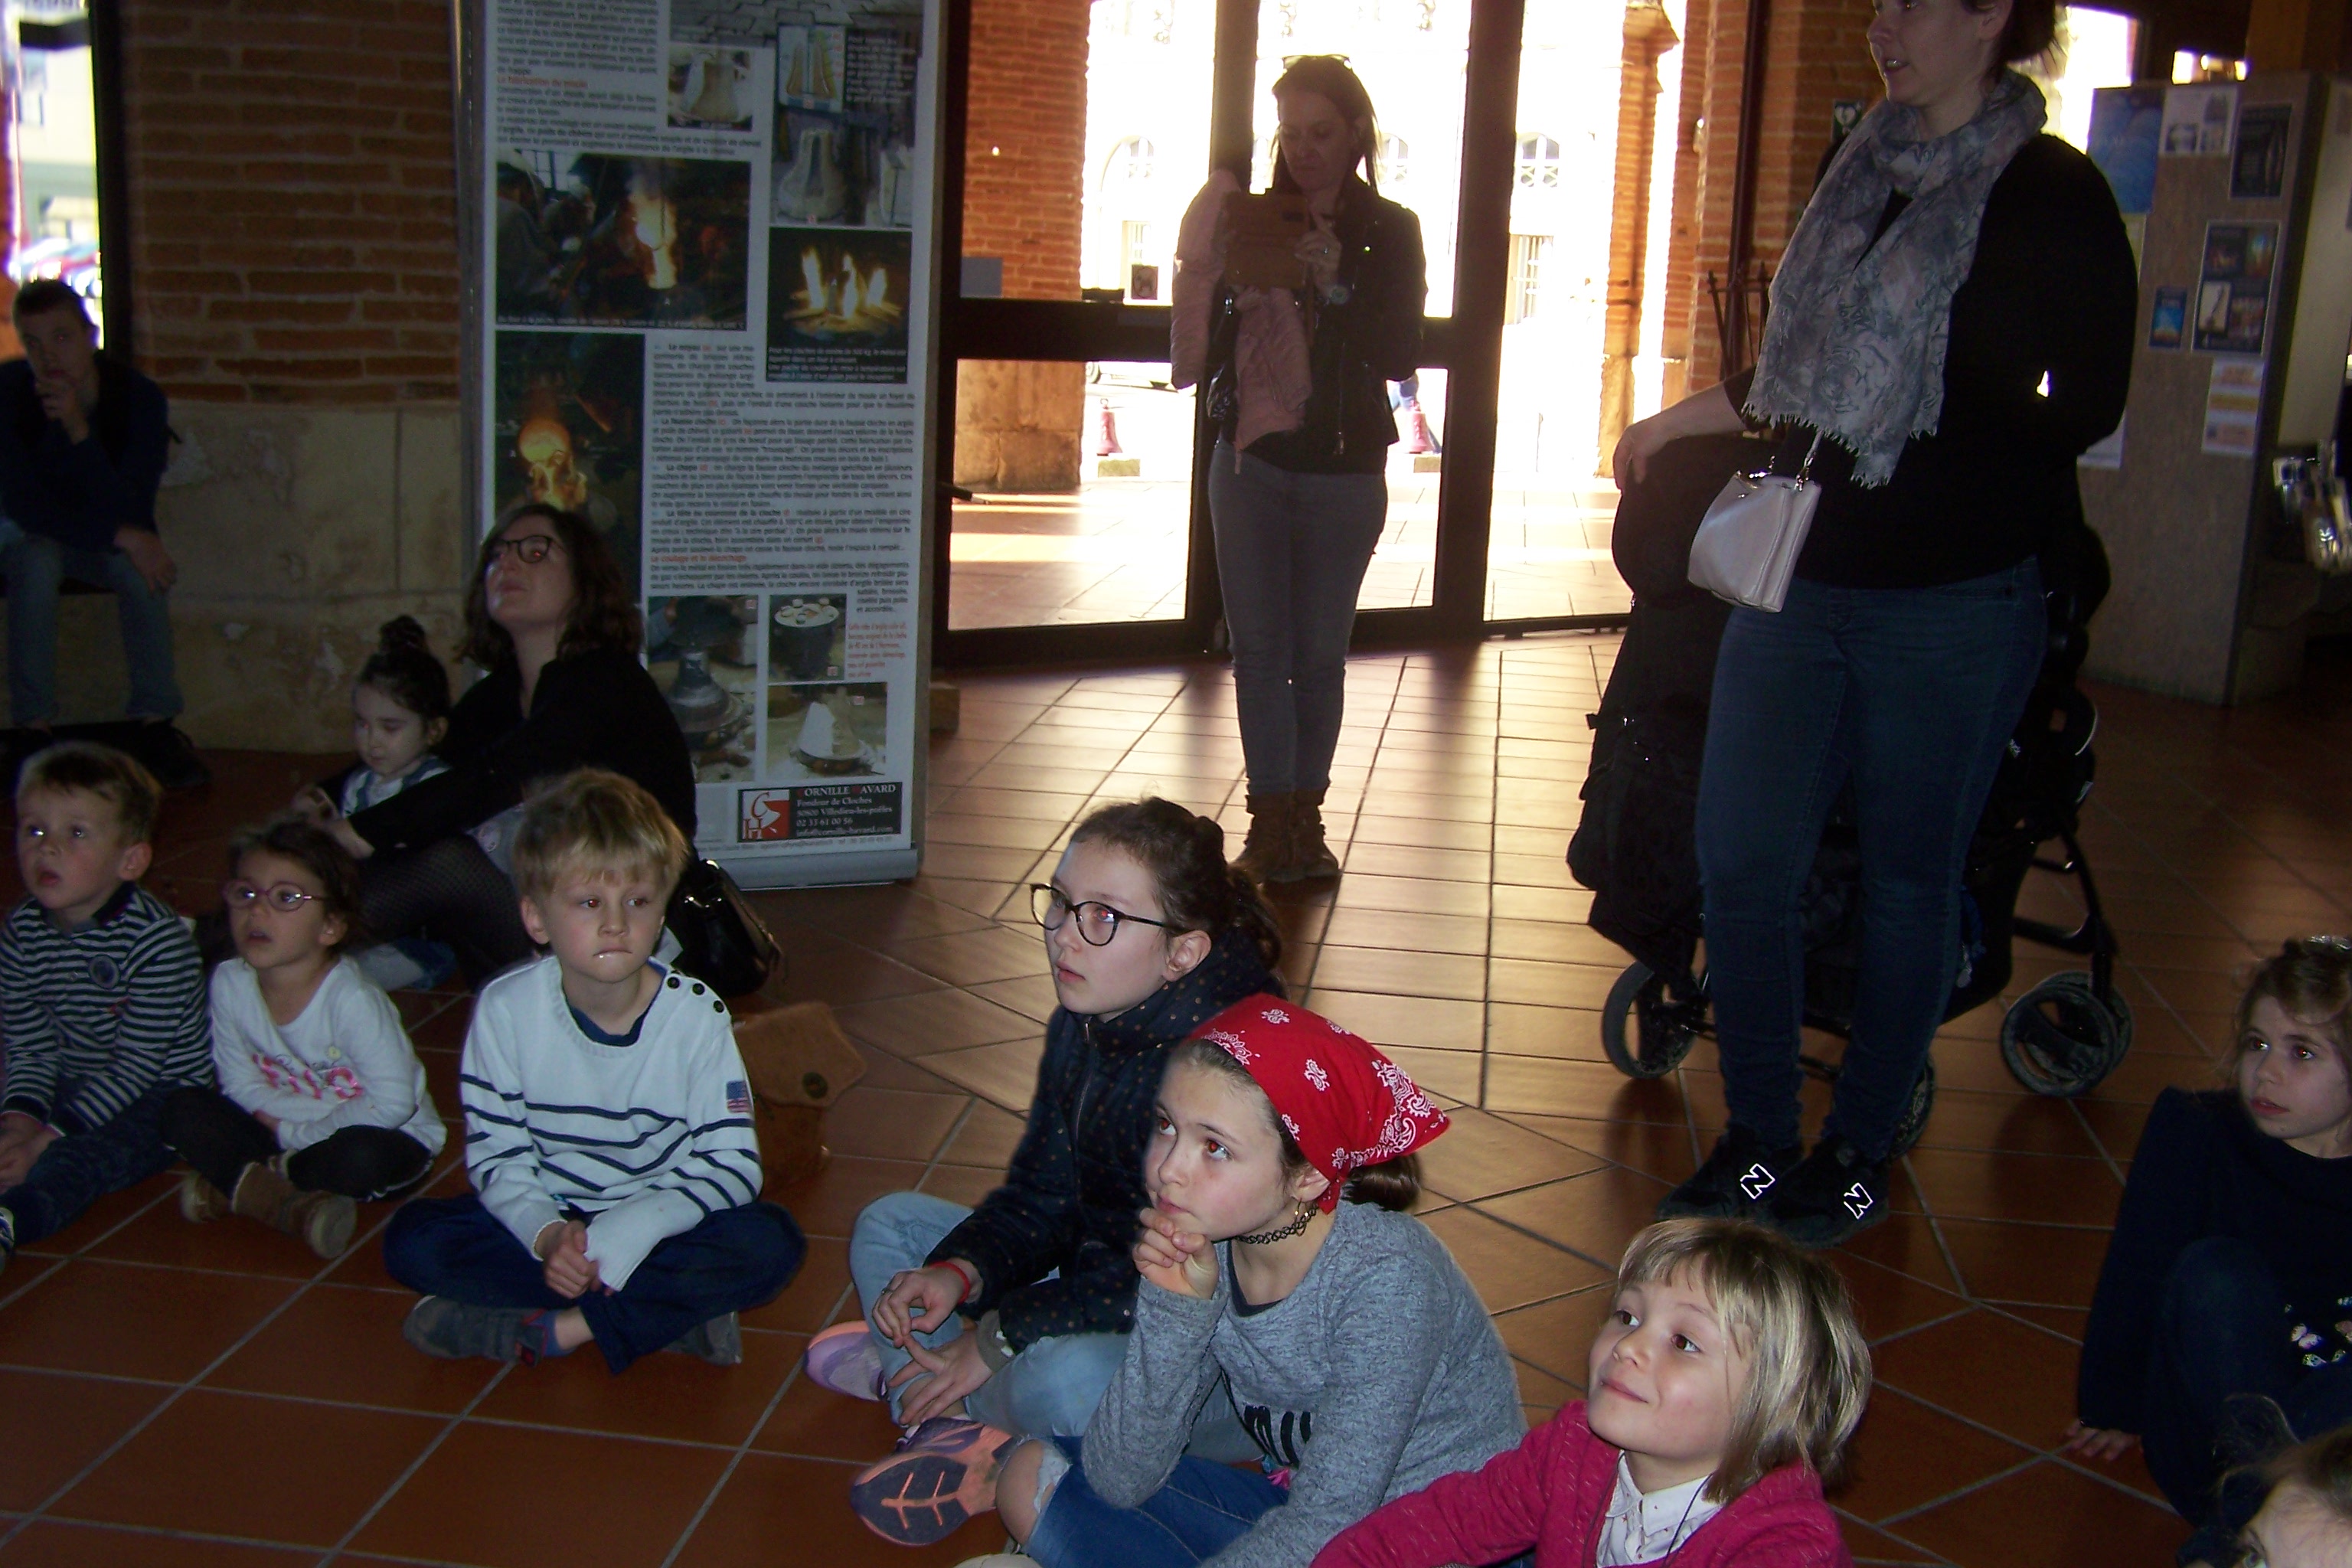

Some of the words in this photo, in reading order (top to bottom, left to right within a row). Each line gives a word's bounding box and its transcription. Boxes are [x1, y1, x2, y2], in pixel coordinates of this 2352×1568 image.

[797, 786, 850, 798] ORNILLE
[852, 784, 897, 795] AVARD
[830, 797, 840, 806] de
[841, 796, 873, 805] Cloches
[1739, 1162, 1776, 1200] N
[1843, 1181, 1874, 1220] N
